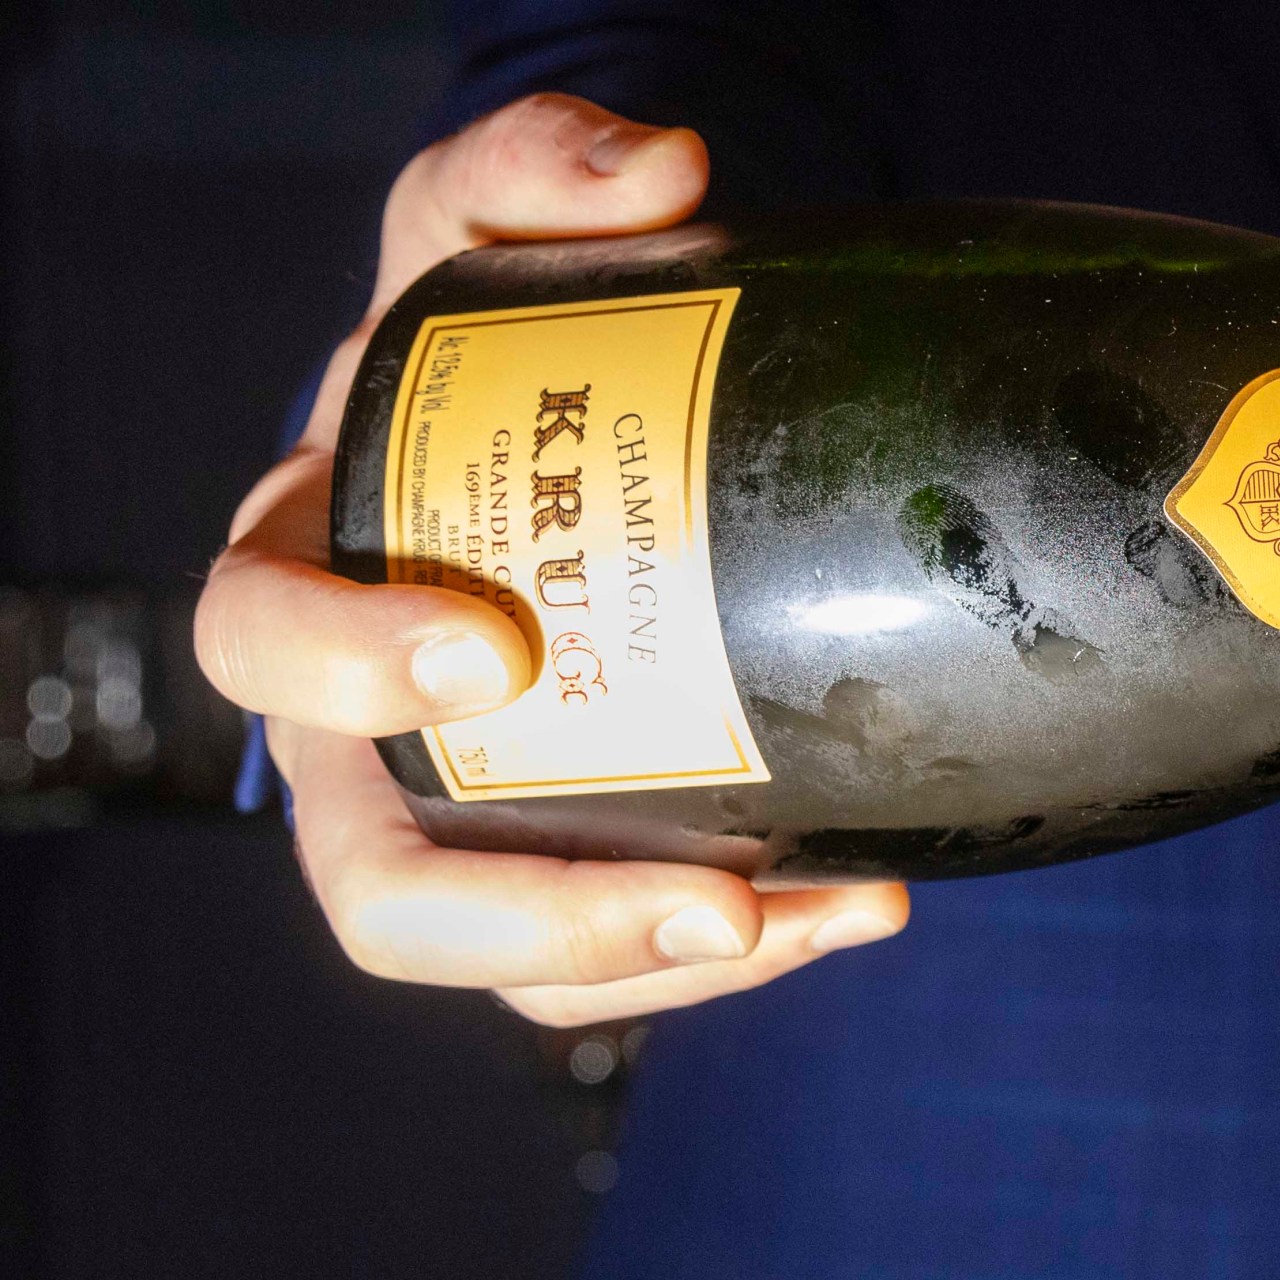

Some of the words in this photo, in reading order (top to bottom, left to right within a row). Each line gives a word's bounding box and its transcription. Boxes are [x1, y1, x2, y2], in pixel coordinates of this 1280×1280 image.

[415, 381, 455, 395] by
[412, 421, 431, 467] PRODUCED
[412, 467, 426, 480] BY
[490, 429, 512, 556] GRANDE
[411, 481, 426, 536] CHAMPAGNE
[427, 509, 442, 552] PRODUCT
[412, 538, 428, 564] KRUG
[428, 553, 443, 565] OF
[447, 525, 461, 573] BRUT
[531, 383, 608, 705] KRUG
[612, 412, 659, 664] CHAMPAGNE
[466, 535, 485, 596] ÉDITI
[456, 746, 489, 765] 750
